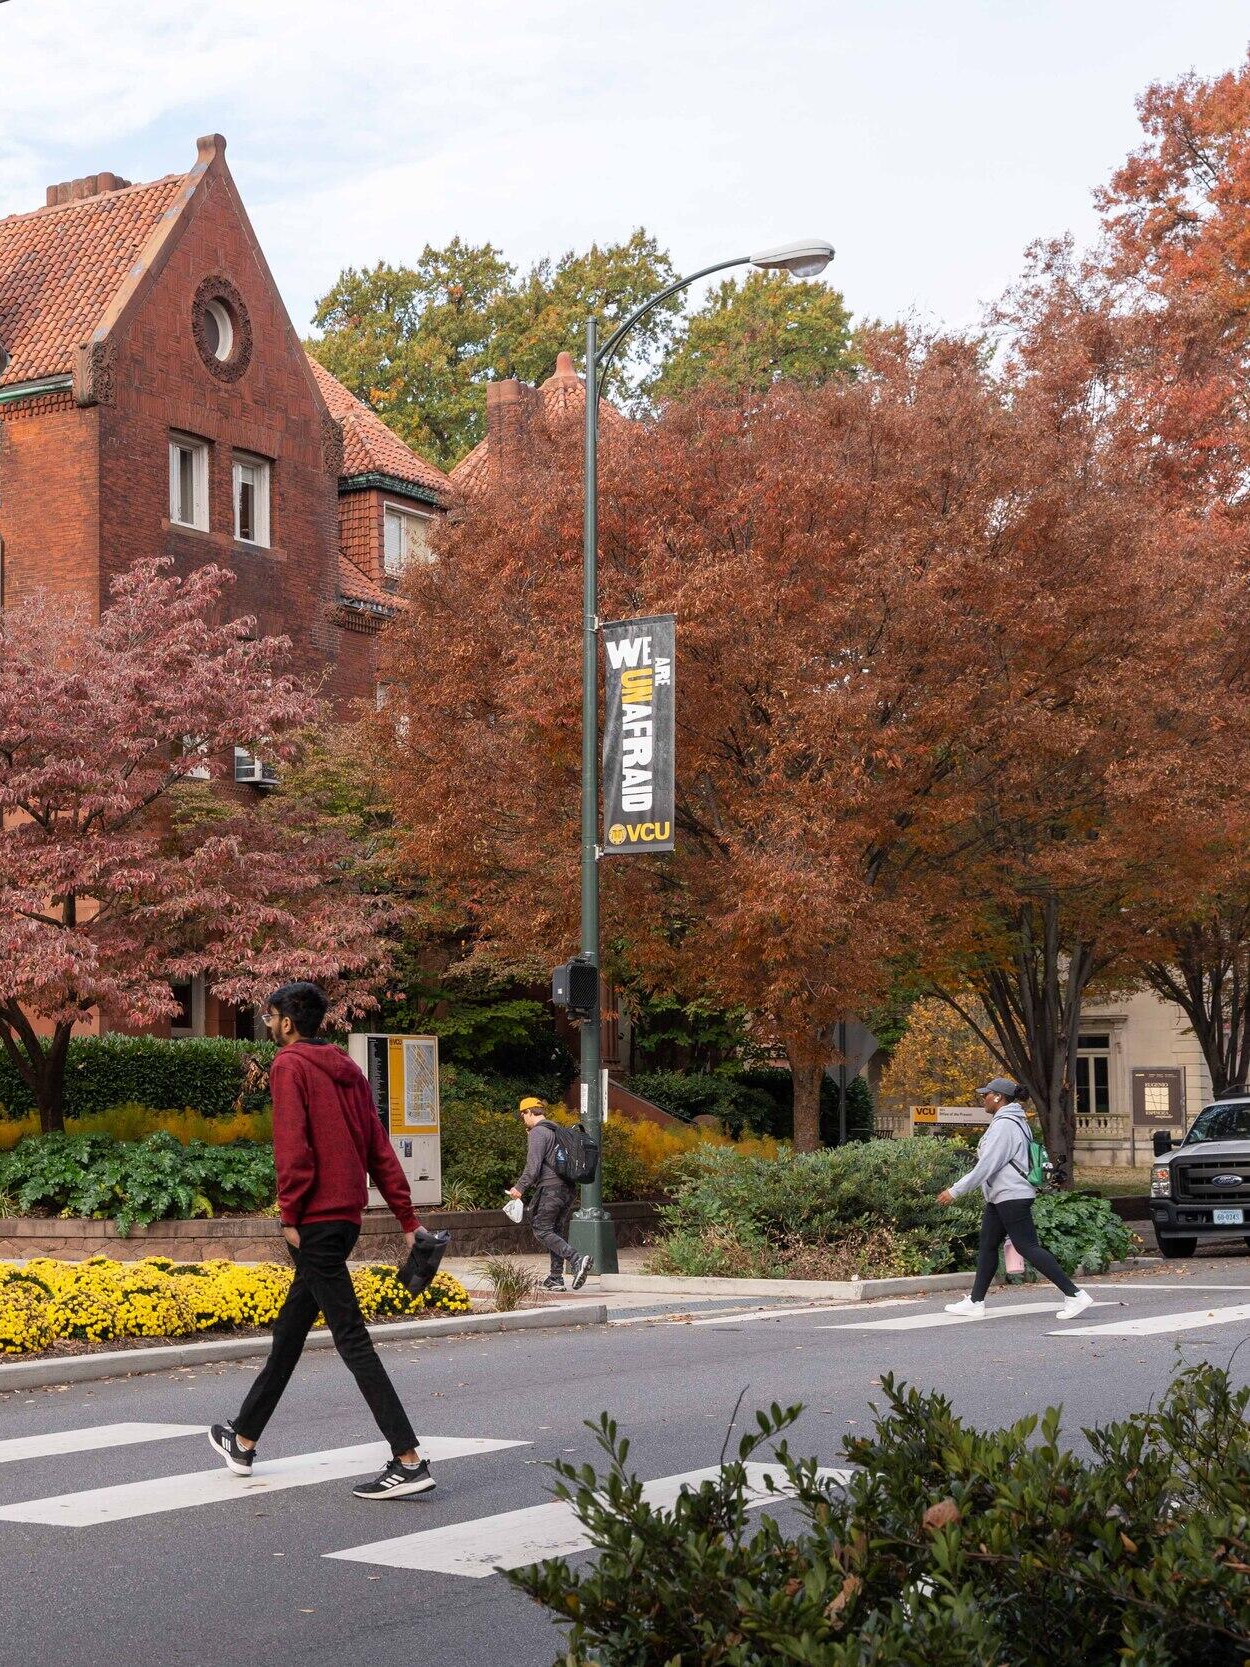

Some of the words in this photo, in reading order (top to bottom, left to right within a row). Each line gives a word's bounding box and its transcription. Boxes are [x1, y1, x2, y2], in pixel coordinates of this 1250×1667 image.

[606, 637, 652, 669] WE
[655, 657, 670, 686] ARE
[621, 668, 653, 812] UNAFRAID
[626, 822, 670, 842] VCU
[916, 1107, 935, 1115] VCU
